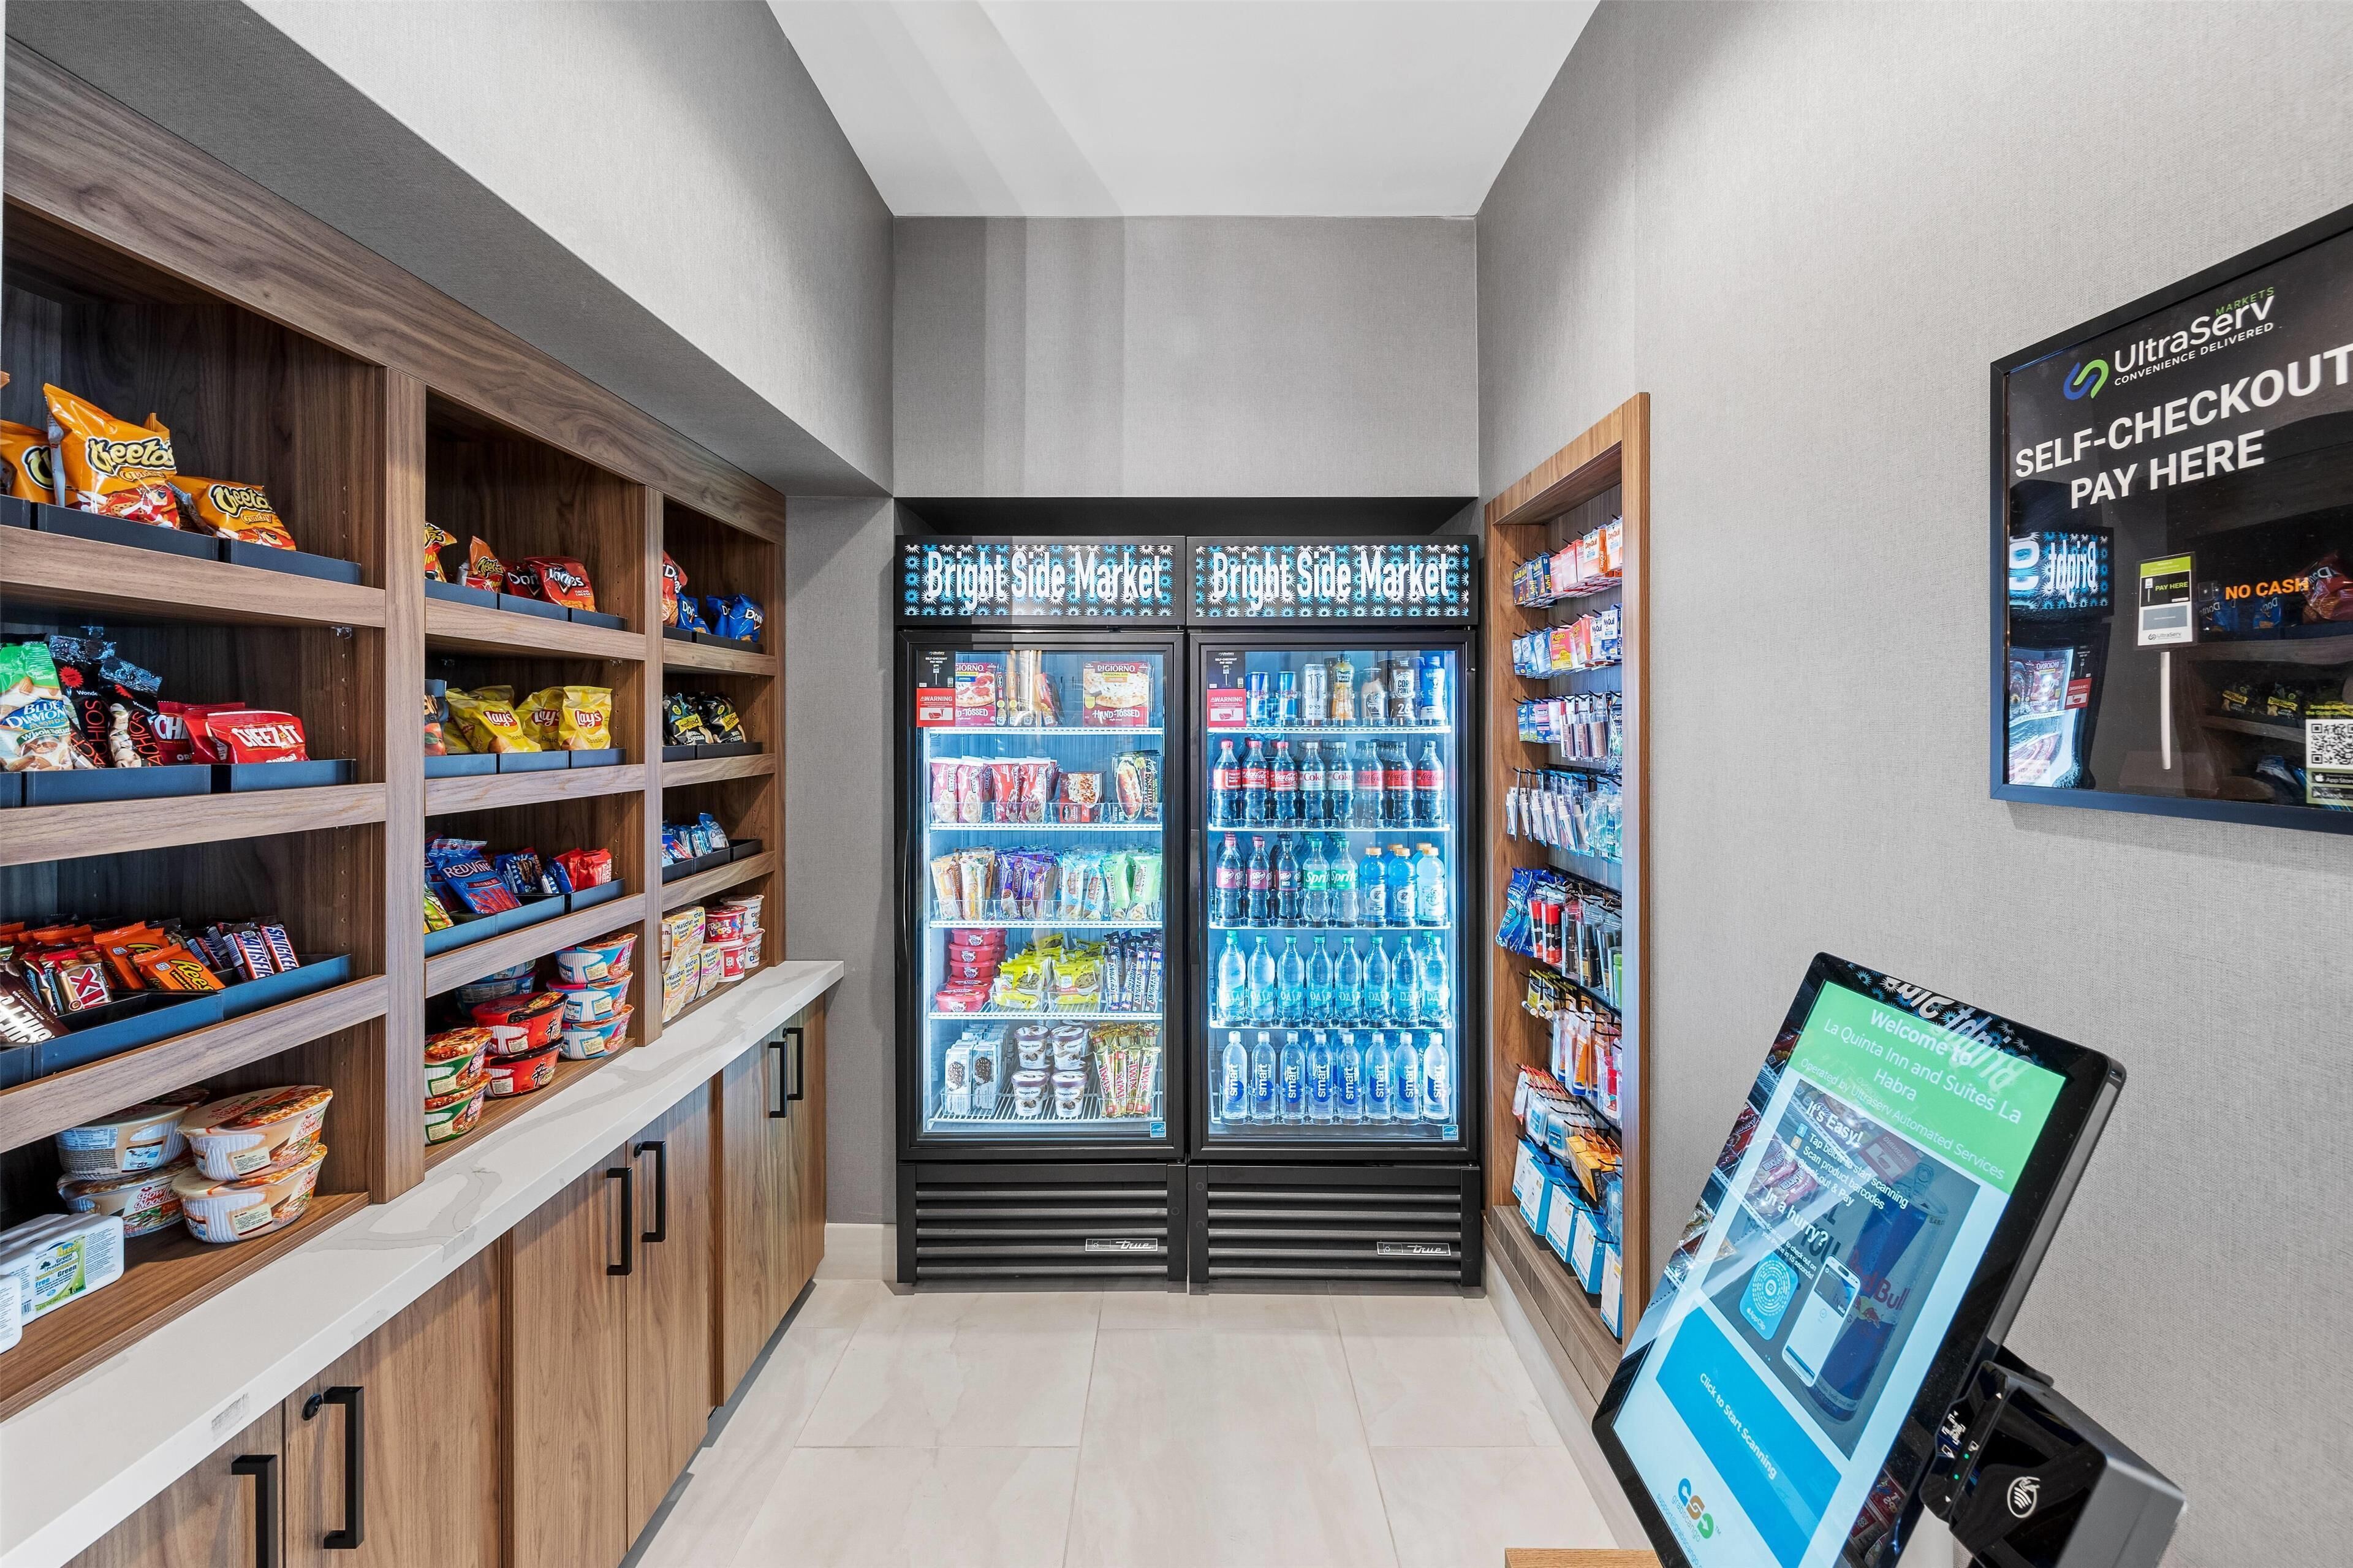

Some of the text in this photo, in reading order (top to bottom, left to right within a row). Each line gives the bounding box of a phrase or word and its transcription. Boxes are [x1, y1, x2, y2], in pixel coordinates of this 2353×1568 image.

[2216, 287, 2275, 316] MARKETS
[2115, 295, 2275, 373] UltraServ
[2114, 322, 2274, 386] CONVENIENCE DELIVERED
[2015, 343, 2353, 478] SELF-CHECKOUT
[86, 436, 176, 476] Cheetos
[2071, 429, 2265, 509] PAY HERE
[119, 469, 165, 482] Crunchy
[210, 485, 276, 517] Cheeto
[241, 512, 273, 524] Crunchy
[1607, 528, 1620, 540] DayQuil
[1585, 539, 1597, 549] DayQuil
[928, 551, 1162, 610] Bright Side Market
[1213, 551, 1449, 610] Bright Side Market
[2225, 577, 2309, 600] NO CASH
[1552, 632, 1566, 642] Pepto
[1603, 618, 1615, 626] NyQuil
[6, 708, 67, 729] DIAMON
[23, 699, 61, 716] BLUE
[487, 710, 514, 727] Lay's
[576, 710, 602, 729] Lay's
[21, 727, 71, 741] Whole Natur
[1304, 773, 1324, 781] Coke
[267, 926, 300, 971] SNICKE
[18, 988, 40, 1011] almonds
[1134, 972, 1143, 1004] SNICKERS
[1147, 971, 1158, 1003] SNICKERS
[1871, 1009, 1974, 1066] Welcome to
[1099, 1064, 1112, 1094] TWIX
[1115, 1072, 1126, 1102] TWIX
[1128, 1061, 1139, 1089] TWIX
[1141, 1062, 1152, 1091] TWIX
[1229, 1063, 1238, 1096] smart
[1258, 1063, 1268, 1096] smart
[1287, 1064, 1297, 1099] smart
[1317, 1064, 1327, 1098] smart
[1344, 1067, 1354, 1100] smart
[1375, 1064, 1384, 1098] smart
[1404, 1064, 1414, 1098] smart
[1433, 1065, 1442, 1099] smart
[1824, 1019, 2022, 1125] La Quinta Inn and Suites La
[1874, 1068, 1917, 1102] Habra
[1800, 1058, 2006, 1180] Operated by Ultraserv Automated Services
[1805, 1100, 1864, 1148] It's Easy!
[1803, 1145, 1885, 1210] Scan product barcodes
[1808, 1133, 1824, 1149] Tap
[1852, 1162, 1872, 1183] start
[1871, 1174, 1909, 1210] scanning
[137, 1186, 170, 1201] Bowl
[1818, 1174, 1832, 1189] out
[1831, 1184, 1838, 1194] &
[1839, 1187, 1855, 1207] Pay
[1777, 1202, 1787, 1214] a
[1786, 1204, 1830, 1248] hurry?
[56, 1252, 73, 1264] Green
[1790, 1244, 1805, 1260] check
[1794, 1257, 1815, 1280] seconds!
[57, 1264, 77, 1278] Green
[1873, 1278, 1911, 1311] Bull
[1700, 1373, 1778, 1480] Click to Start Scanning
[1672, 1494, 1701, 1542] grabscango
